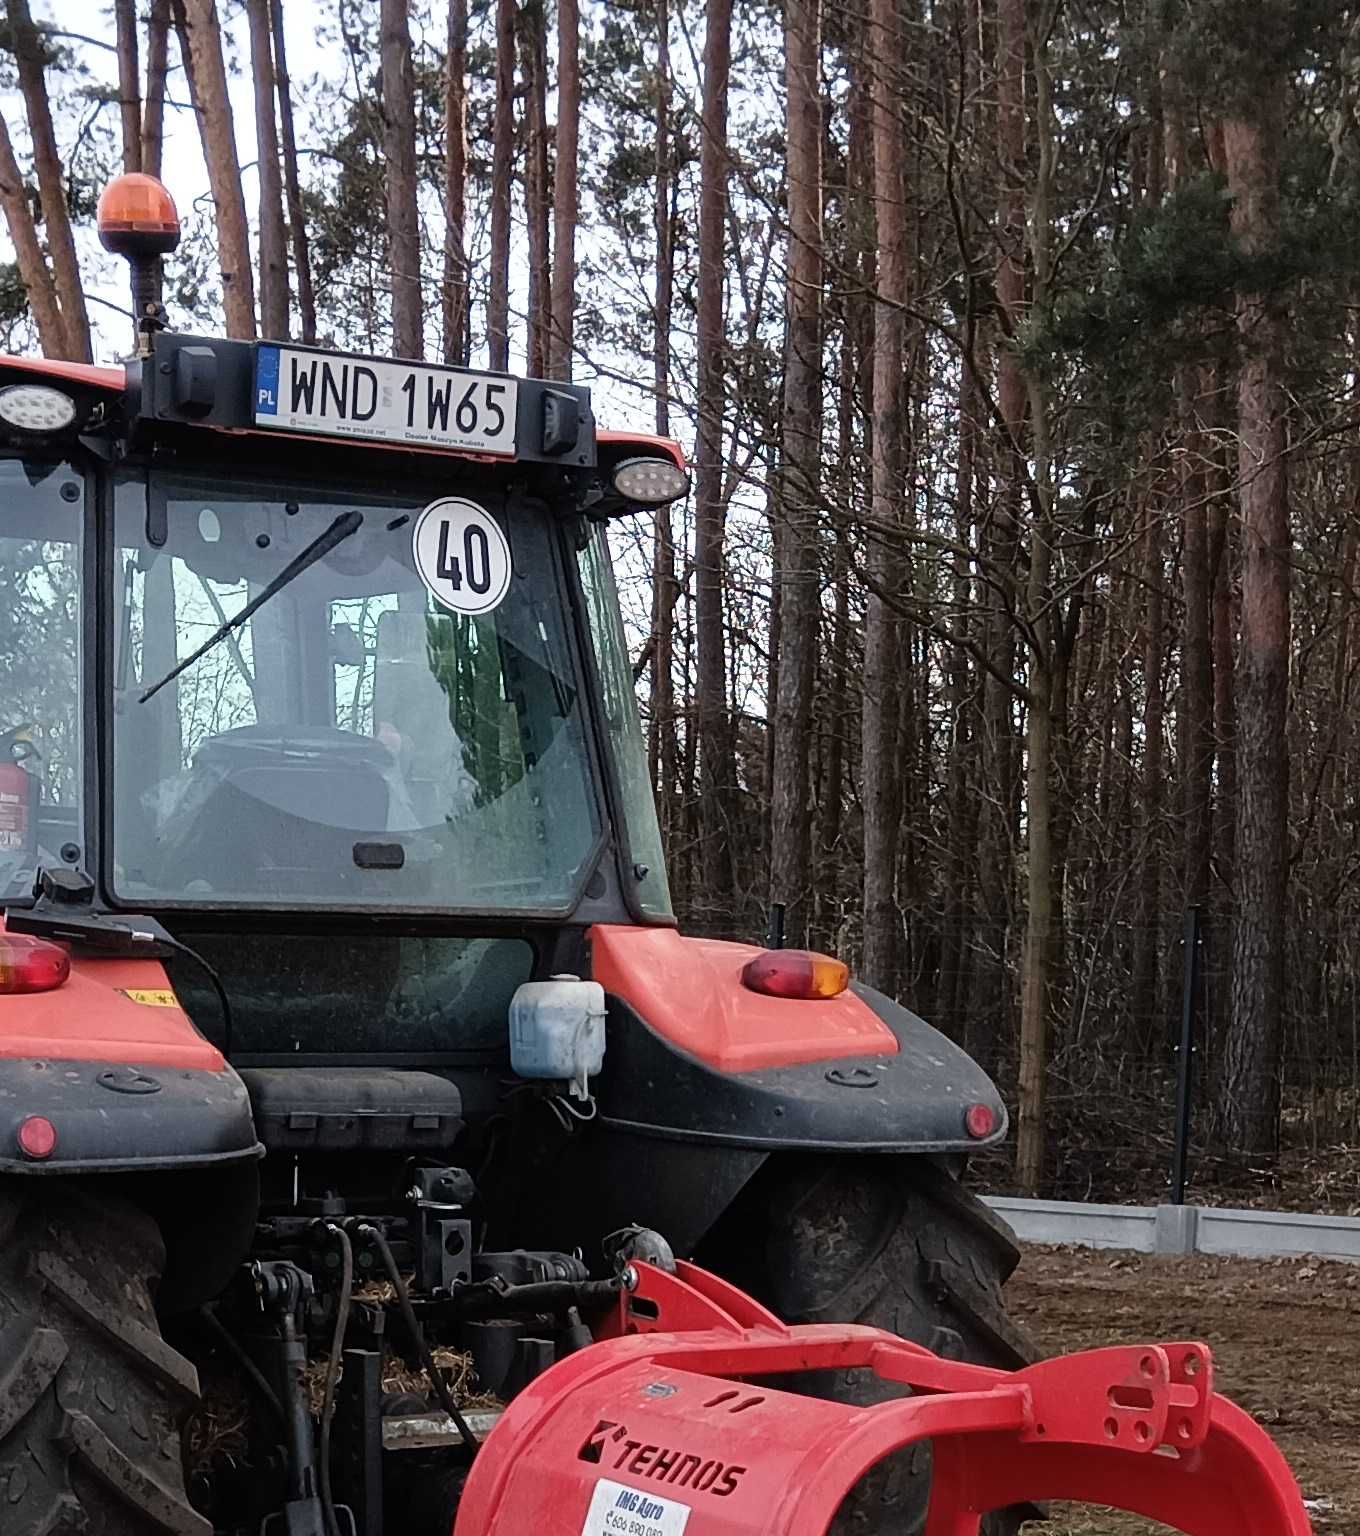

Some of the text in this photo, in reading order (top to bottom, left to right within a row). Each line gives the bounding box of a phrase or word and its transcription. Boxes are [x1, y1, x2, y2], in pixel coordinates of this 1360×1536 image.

[258, 388, 276, 406] PL
[291, 357, 506, 437] WND 1W65
[436, 520, 491, 595] 40
[612, 1440, 748, 1497] TEHNOS
[611, 1515, 628, 1531] 606
[628, 1521, 646, 1536] 890
[615, 1490, 664, 1520] IMG Agro
